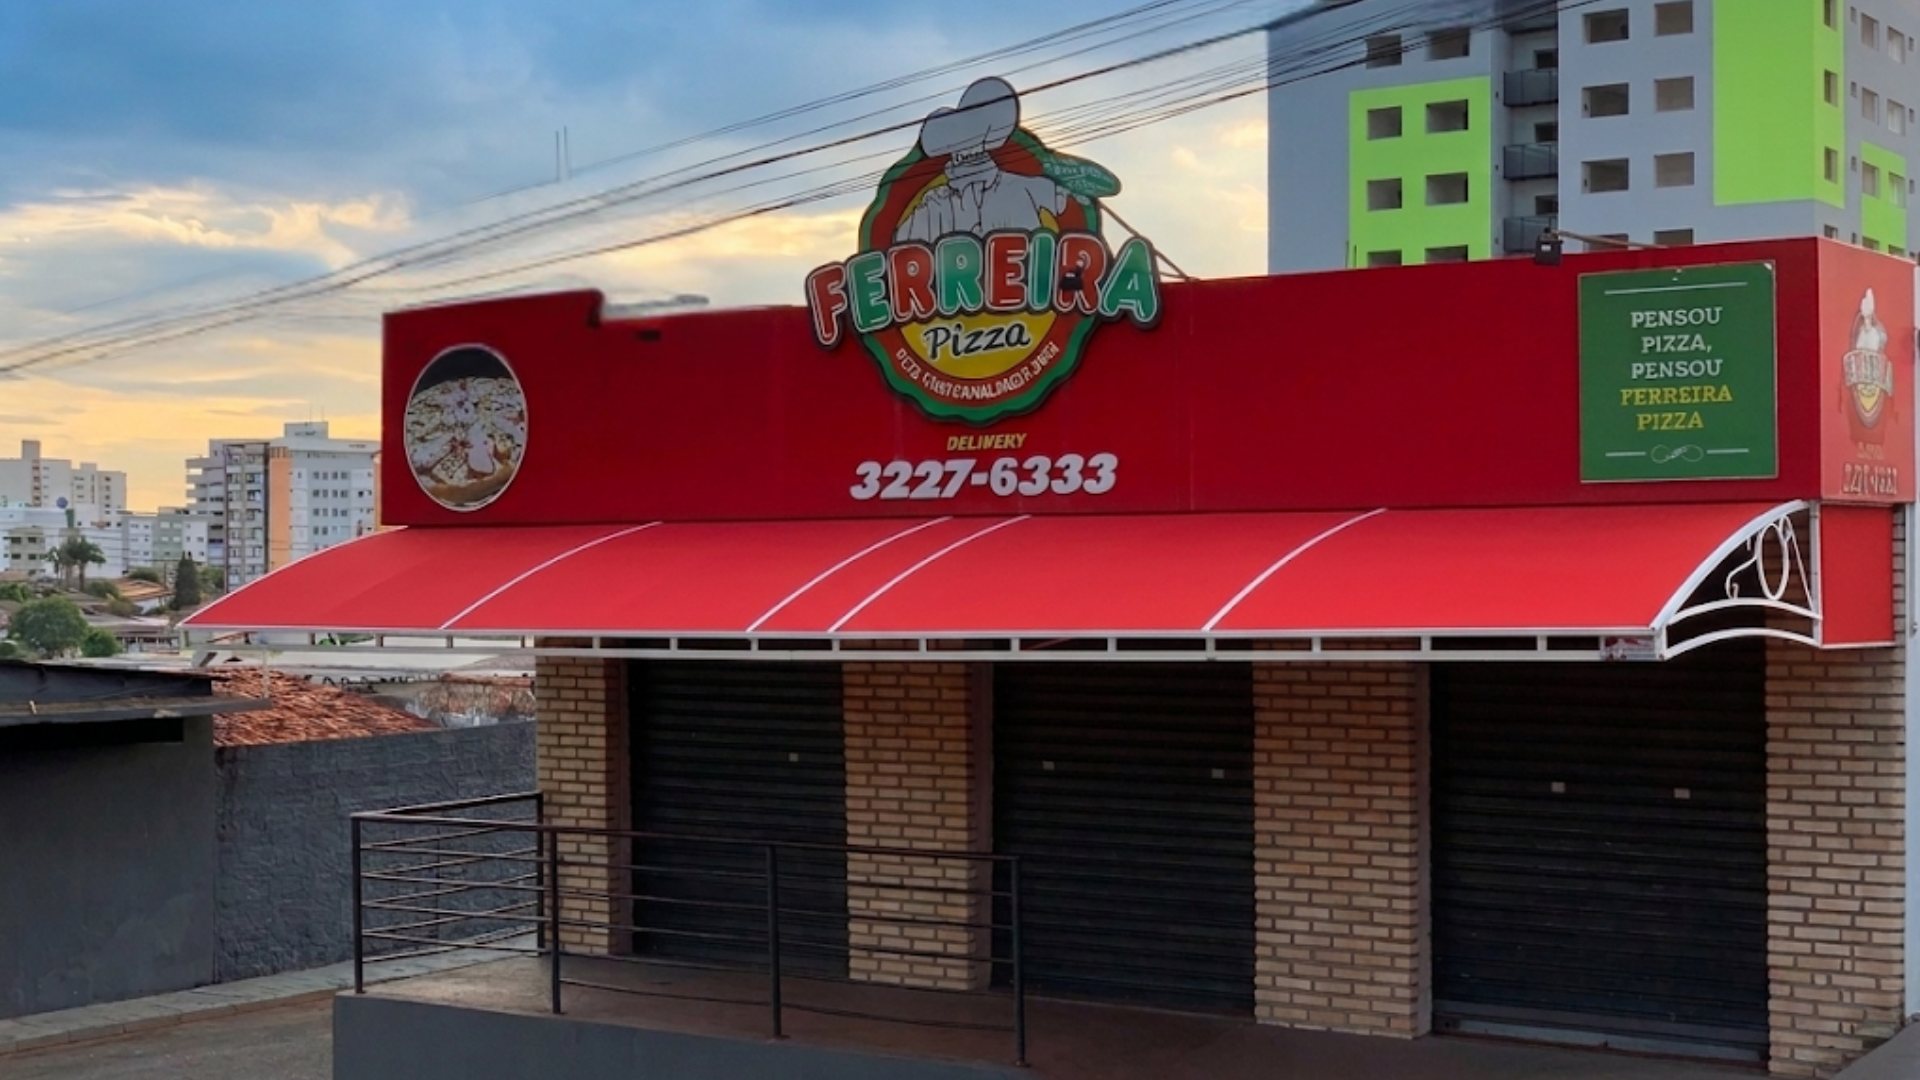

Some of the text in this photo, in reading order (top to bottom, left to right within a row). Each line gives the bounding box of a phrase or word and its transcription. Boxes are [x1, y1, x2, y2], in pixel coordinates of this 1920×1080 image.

[806, 232, 1159, 345] FERREIRA
[1630, 306, 1723, 329] PENSOU
[923, 323, 1031, 359] Pizza
[1641, 333, 1713, 354] PIZZA,
[1631, 359, 1723, 380] PENSOU
[1620, 384, 1734, 406] FERREIRA
[1637, 411, 1704, 432] PIZZA
[946, 433, 1027, 452] DELIVERY
[850, 453, 1118, 500] 3227-6333
